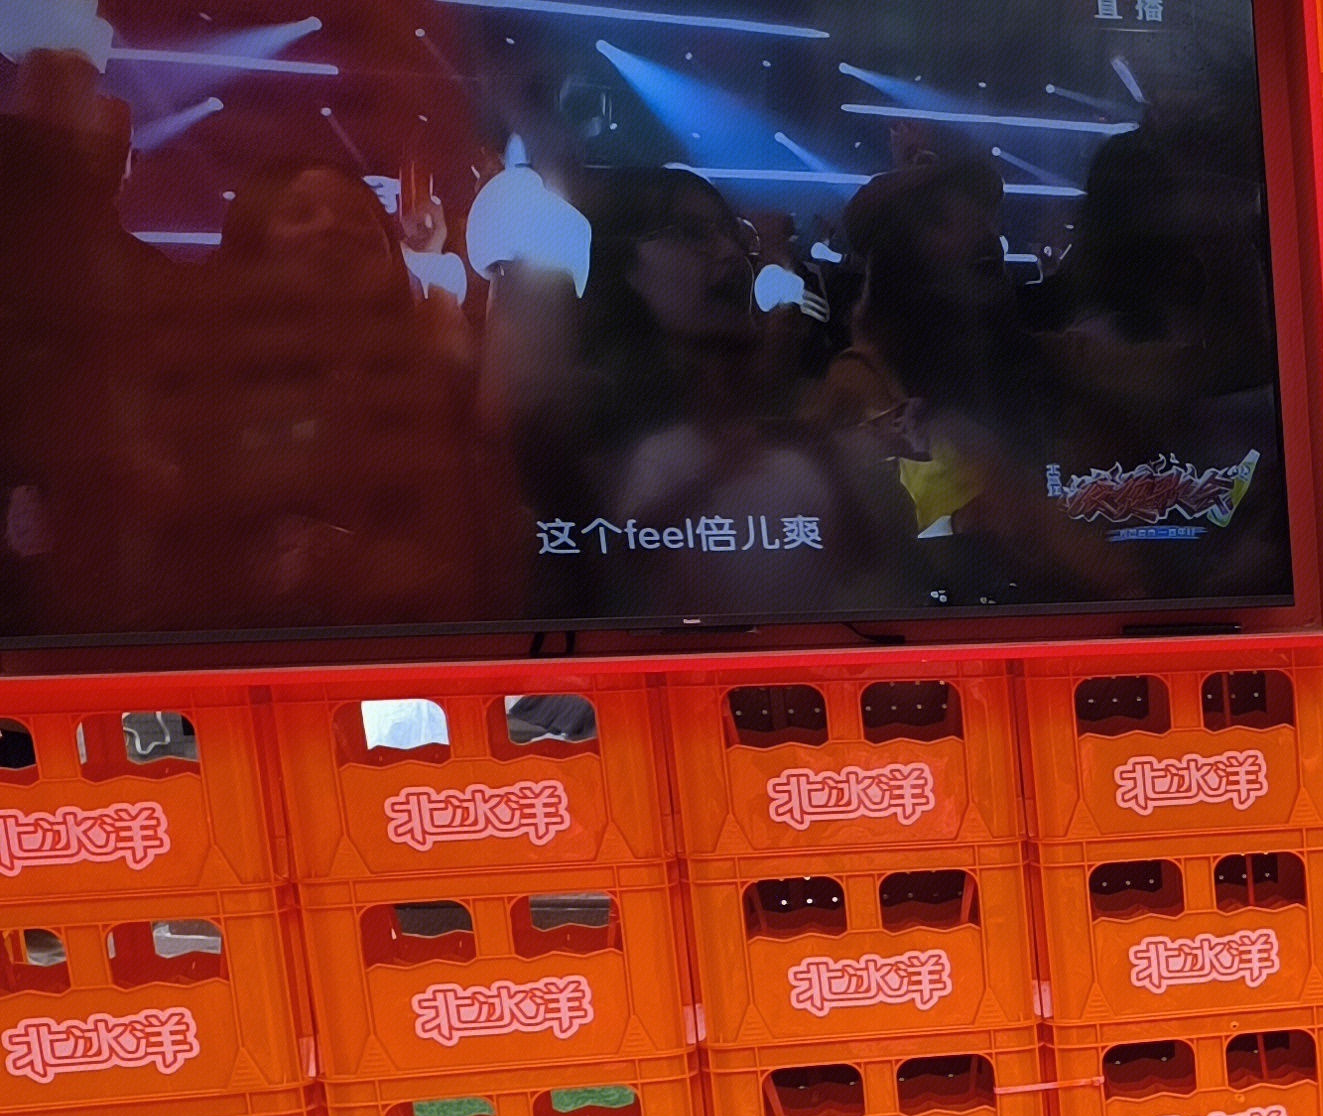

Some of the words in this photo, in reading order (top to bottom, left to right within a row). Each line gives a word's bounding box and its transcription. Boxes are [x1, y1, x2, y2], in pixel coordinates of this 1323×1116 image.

[537, 515, 823, 555] 这个feel倍儿爽
[385, 780, 570, 851] 北冰洋
[768, 763, 936, 830] 北冰洋
[1114, 750, 1268, 815] 北冰洋
[788, 950, 952, 1017] 北冰洋
[1129, 929, 1280, 993] 北冰洋
[412, 975, 594, 1046] 北冰洋
[2, 1008, 200, 1083] 北冰洋
